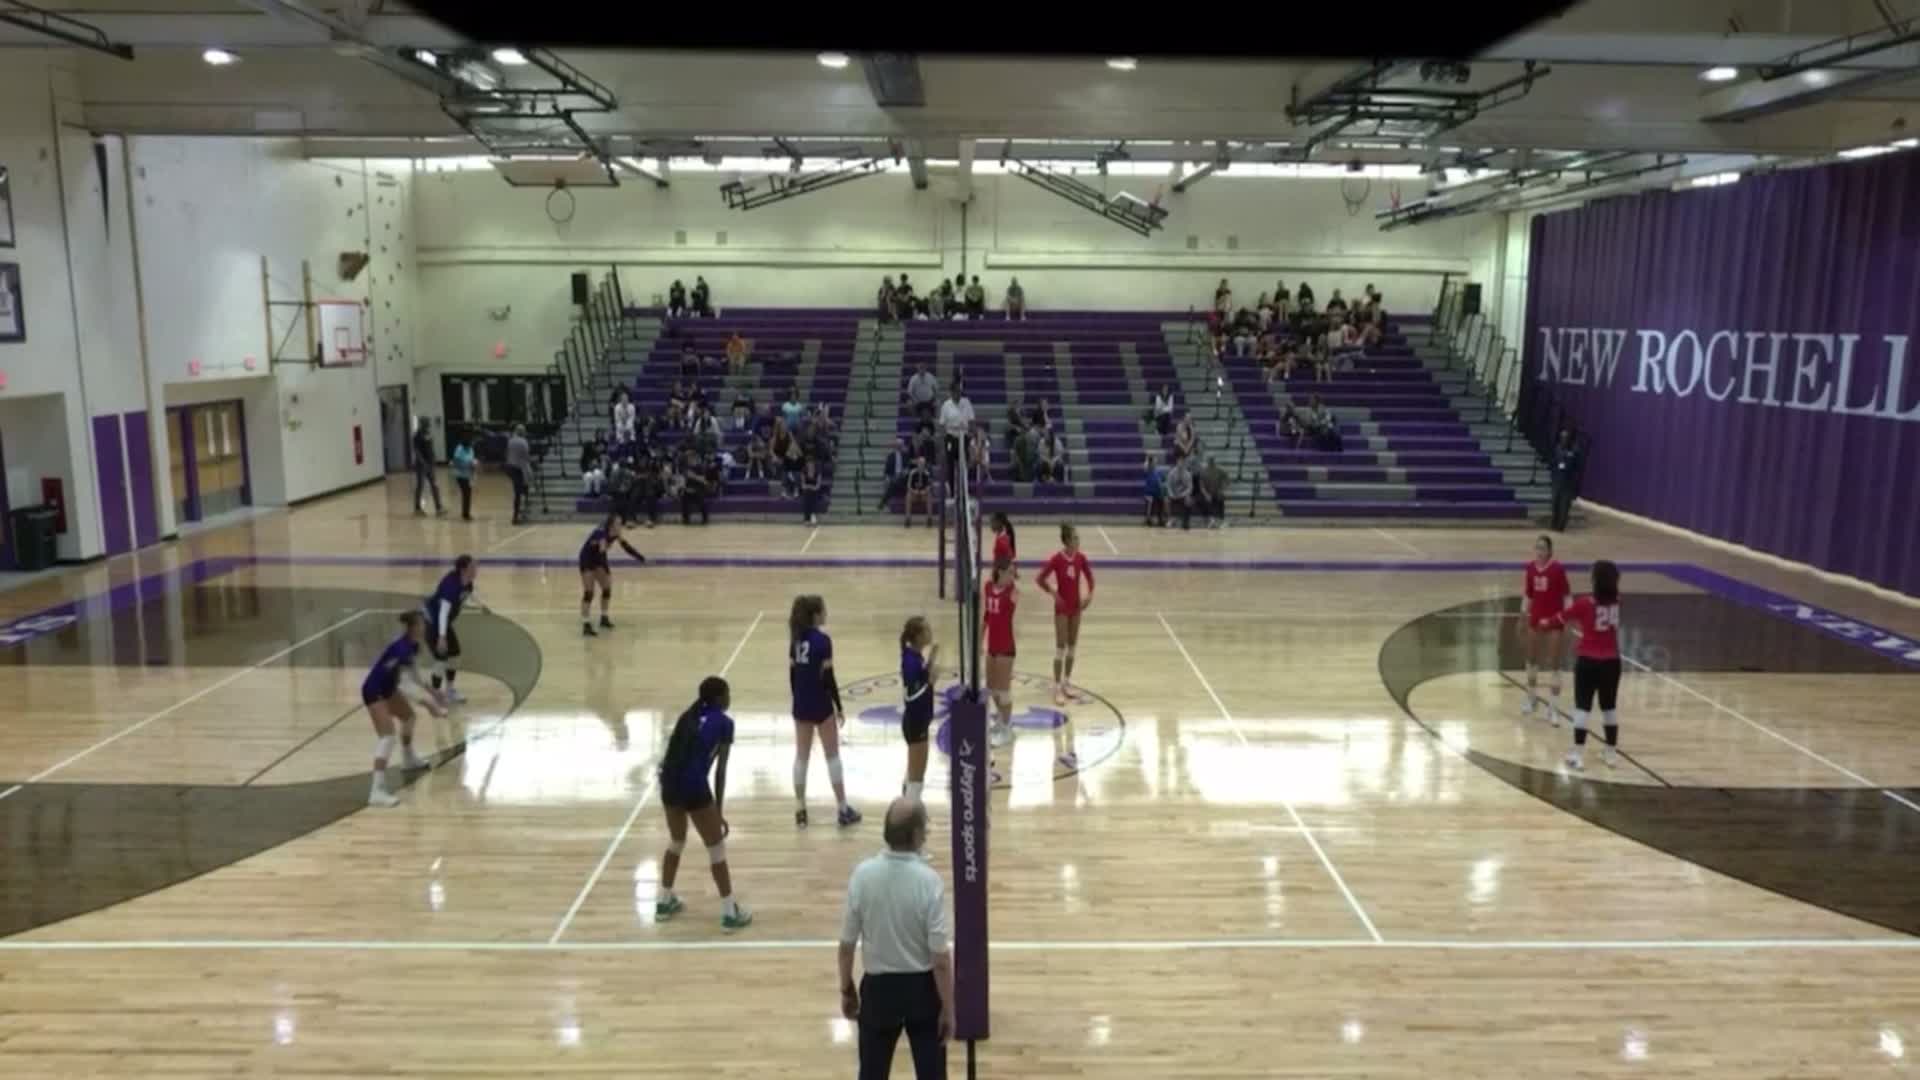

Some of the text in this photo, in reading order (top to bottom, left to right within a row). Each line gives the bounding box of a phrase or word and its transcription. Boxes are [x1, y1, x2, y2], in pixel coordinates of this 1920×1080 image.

[1538, 326, 1627, 389] NEW
[1594, 605, 1619, 631] 24
[961, 824, 979, 882] sports
